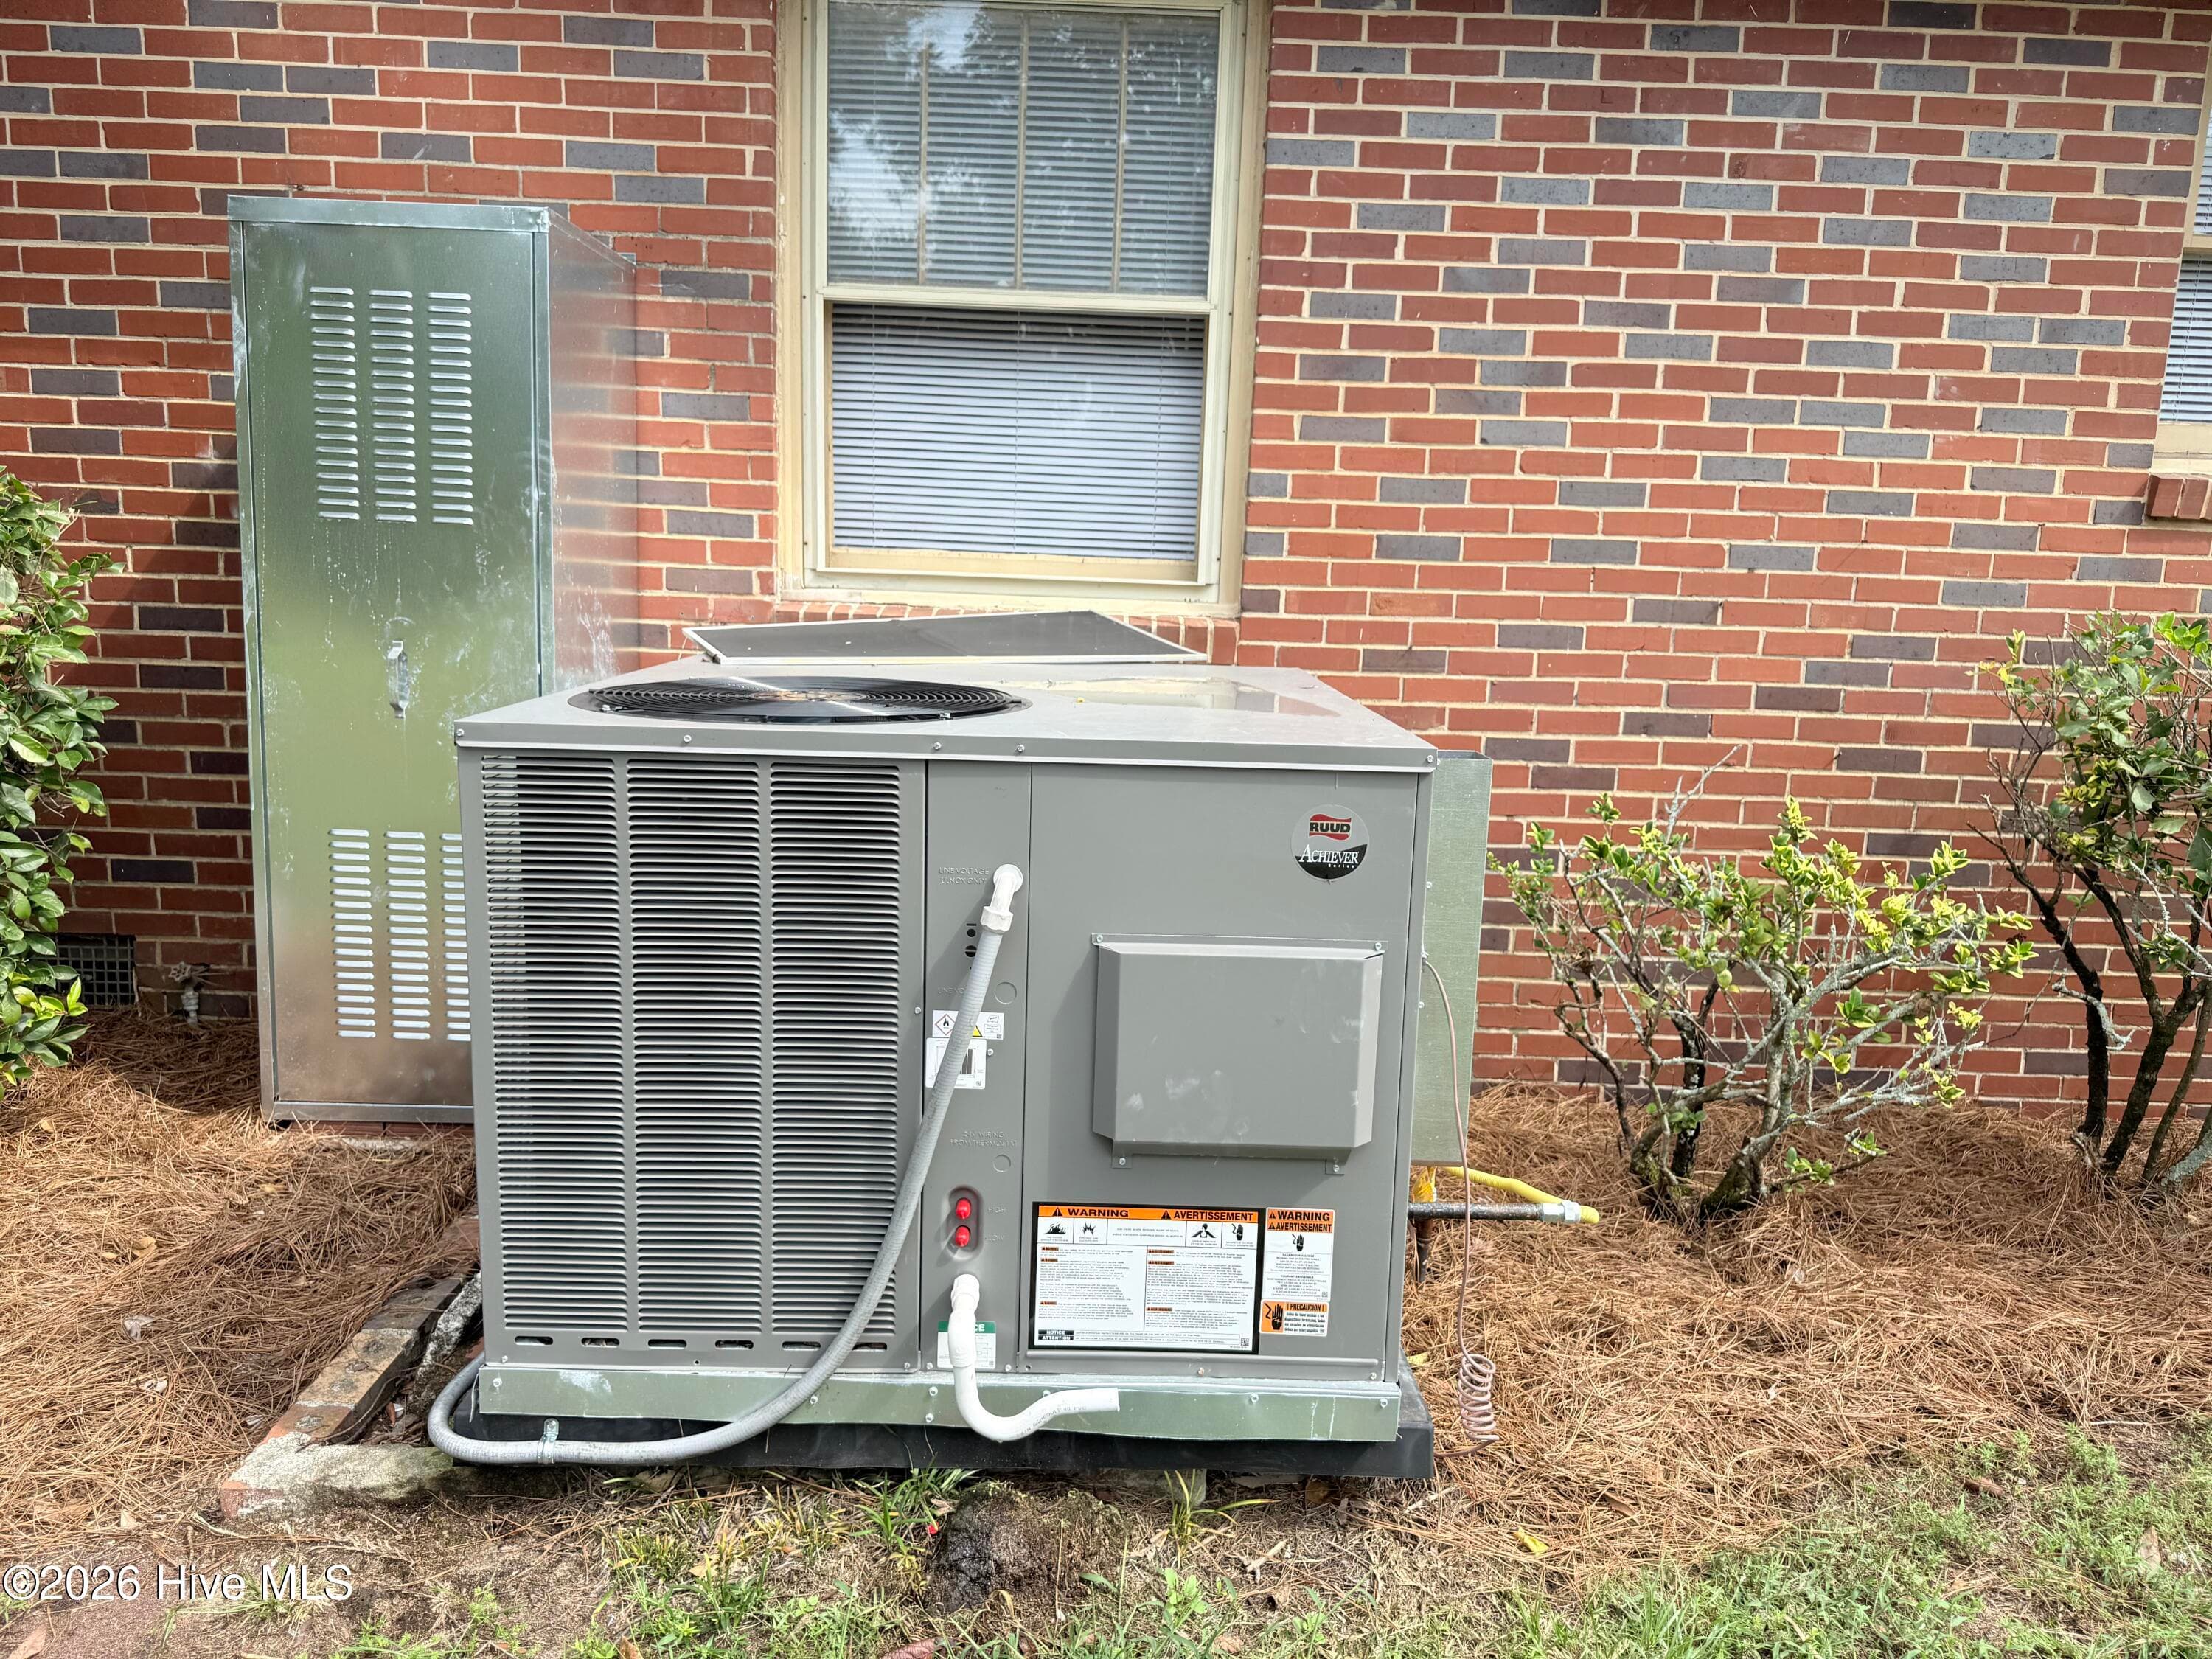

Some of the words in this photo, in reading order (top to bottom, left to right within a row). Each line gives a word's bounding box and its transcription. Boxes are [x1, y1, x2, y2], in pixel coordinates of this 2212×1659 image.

[1309, 822, 1351, 833] RUUD
[939, 866, 955, 874] LINE
[956, 867, 990, 875] VOLTAGE
[967, 877, 987, 885] ONLY
[1068, 1208, 1129, 1217] WARNING
[1174, 1211, 1253, 1221] AVERTISSEMENT
[1277, 1210, 1330, 1221] WARNING
[1276, 1222, 1332, 1232] AVERTISSEMENT
